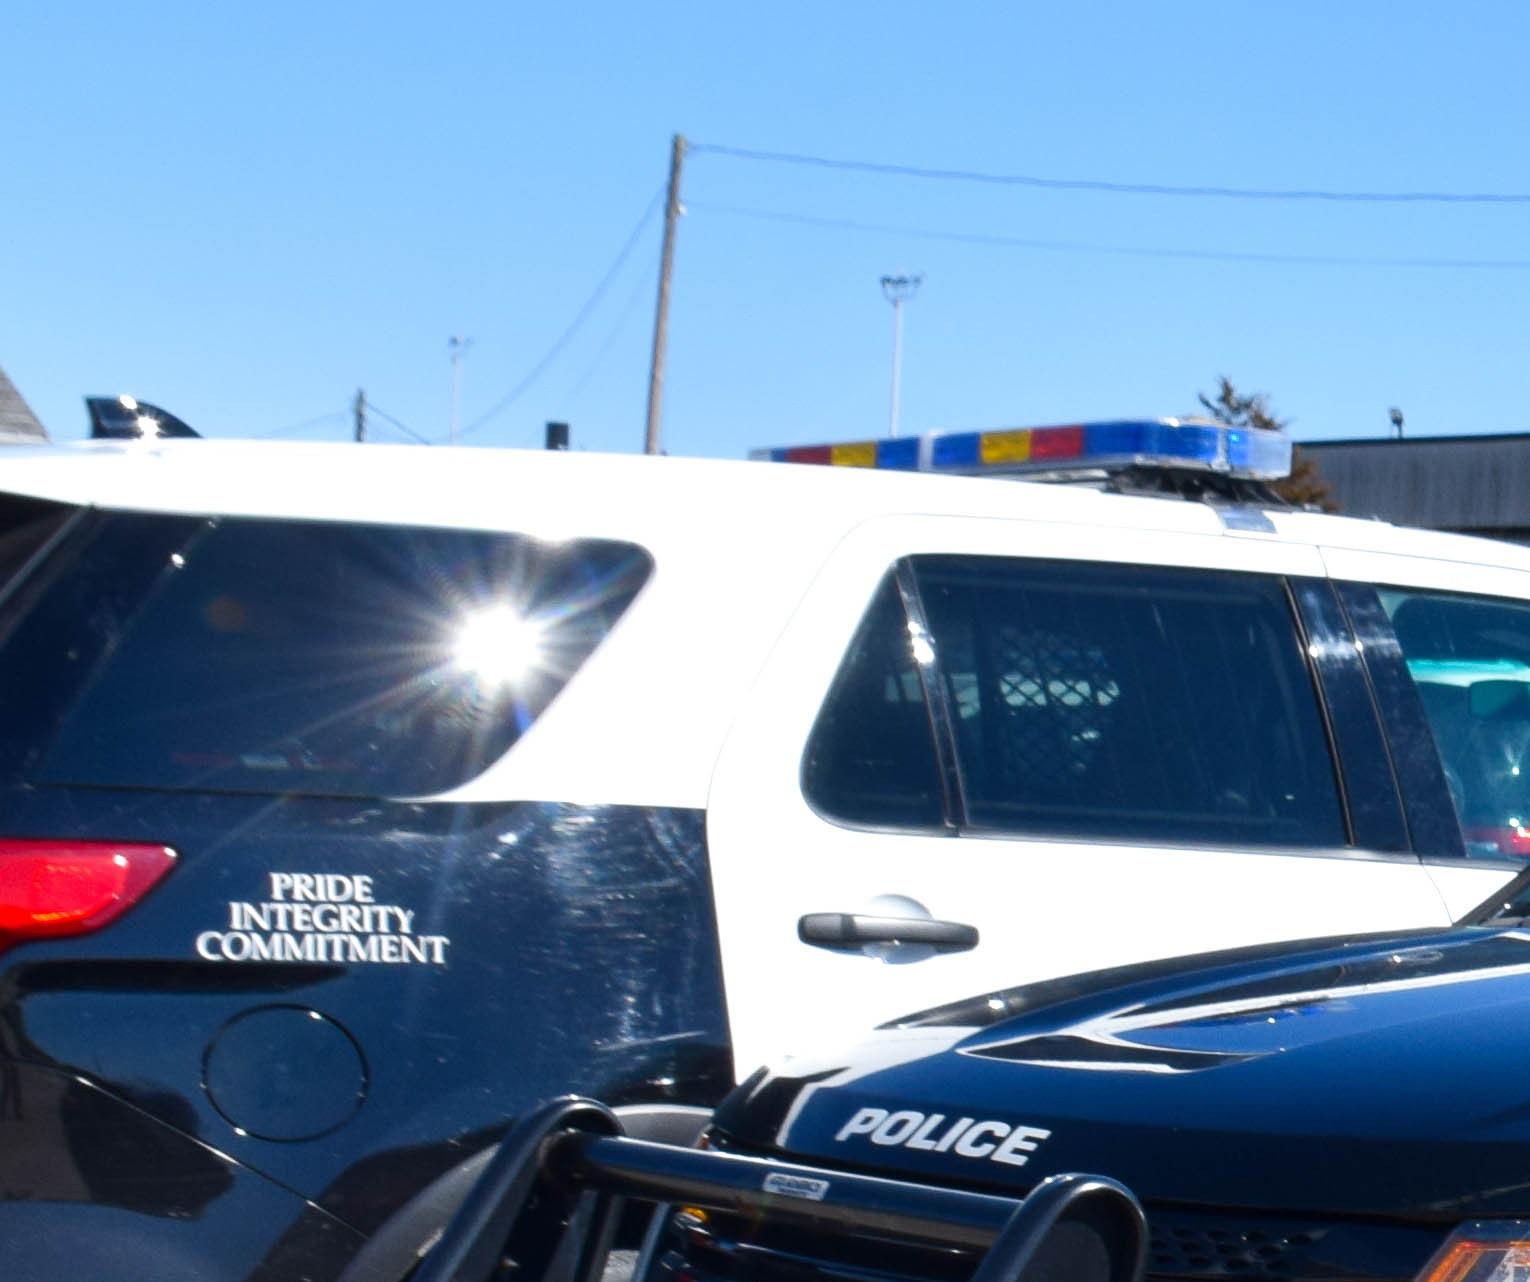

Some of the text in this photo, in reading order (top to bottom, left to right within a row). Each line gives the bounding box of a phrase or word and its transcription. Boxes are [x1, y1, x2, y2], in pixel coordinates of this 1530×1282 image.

[269, 872, 375, 902] PRIDE
[229, 902, 415, 933] INTEGRITY
[196, 931, 450, 963] COMMITMENT
[835, 1107, 1051, 1166] POLICE
